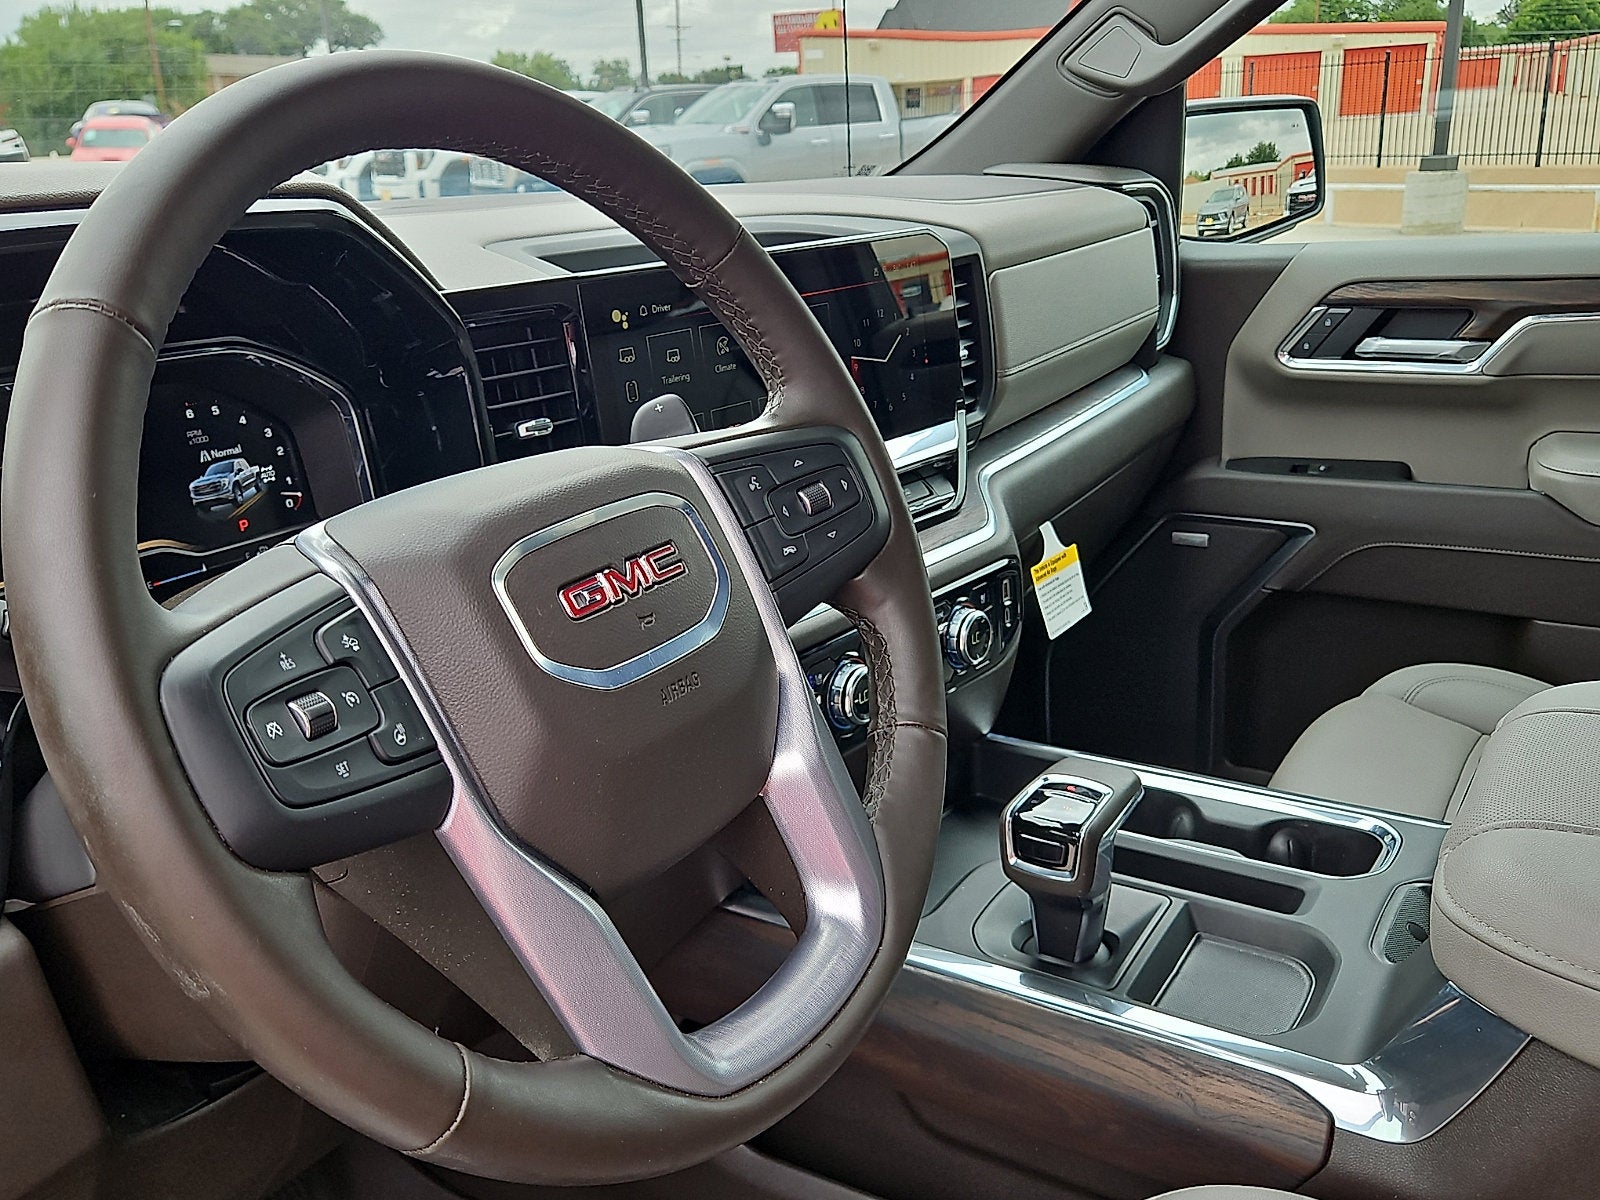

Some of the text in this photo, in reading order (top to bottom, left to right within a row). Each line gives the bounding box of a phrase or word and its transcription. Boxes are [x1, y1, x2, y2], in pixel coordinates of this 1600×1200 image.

[652, 304, 671, 314] Driver
[876, 308, 885, 318] 12
[862, 318, 870, 327] 11
[853, 338, 862, 348] 10
[715, 363, 736, 373] Climate
[661, 373, 690, 385] Trailering
[185, 409, 195, 419] 6
[211, 405, 220, 415] 5
[239, 416, 247, 425] 4
[186, 429, 202, 438] RPM
[264, 428, 273, 437] 3
[210, 443, 243, 459] Normal
[276, 446, 285, 456] 2
[286, 476, 292, 485] 1
[285, 498, 293, 508] 0
[239, 519, 249, 532] P
[557, 540, 688, 622] GMC
[279, 657, 296, 671] RES
[659, 671, 701, 707] AIRBAG
[335, 761, 349, 774] SET
